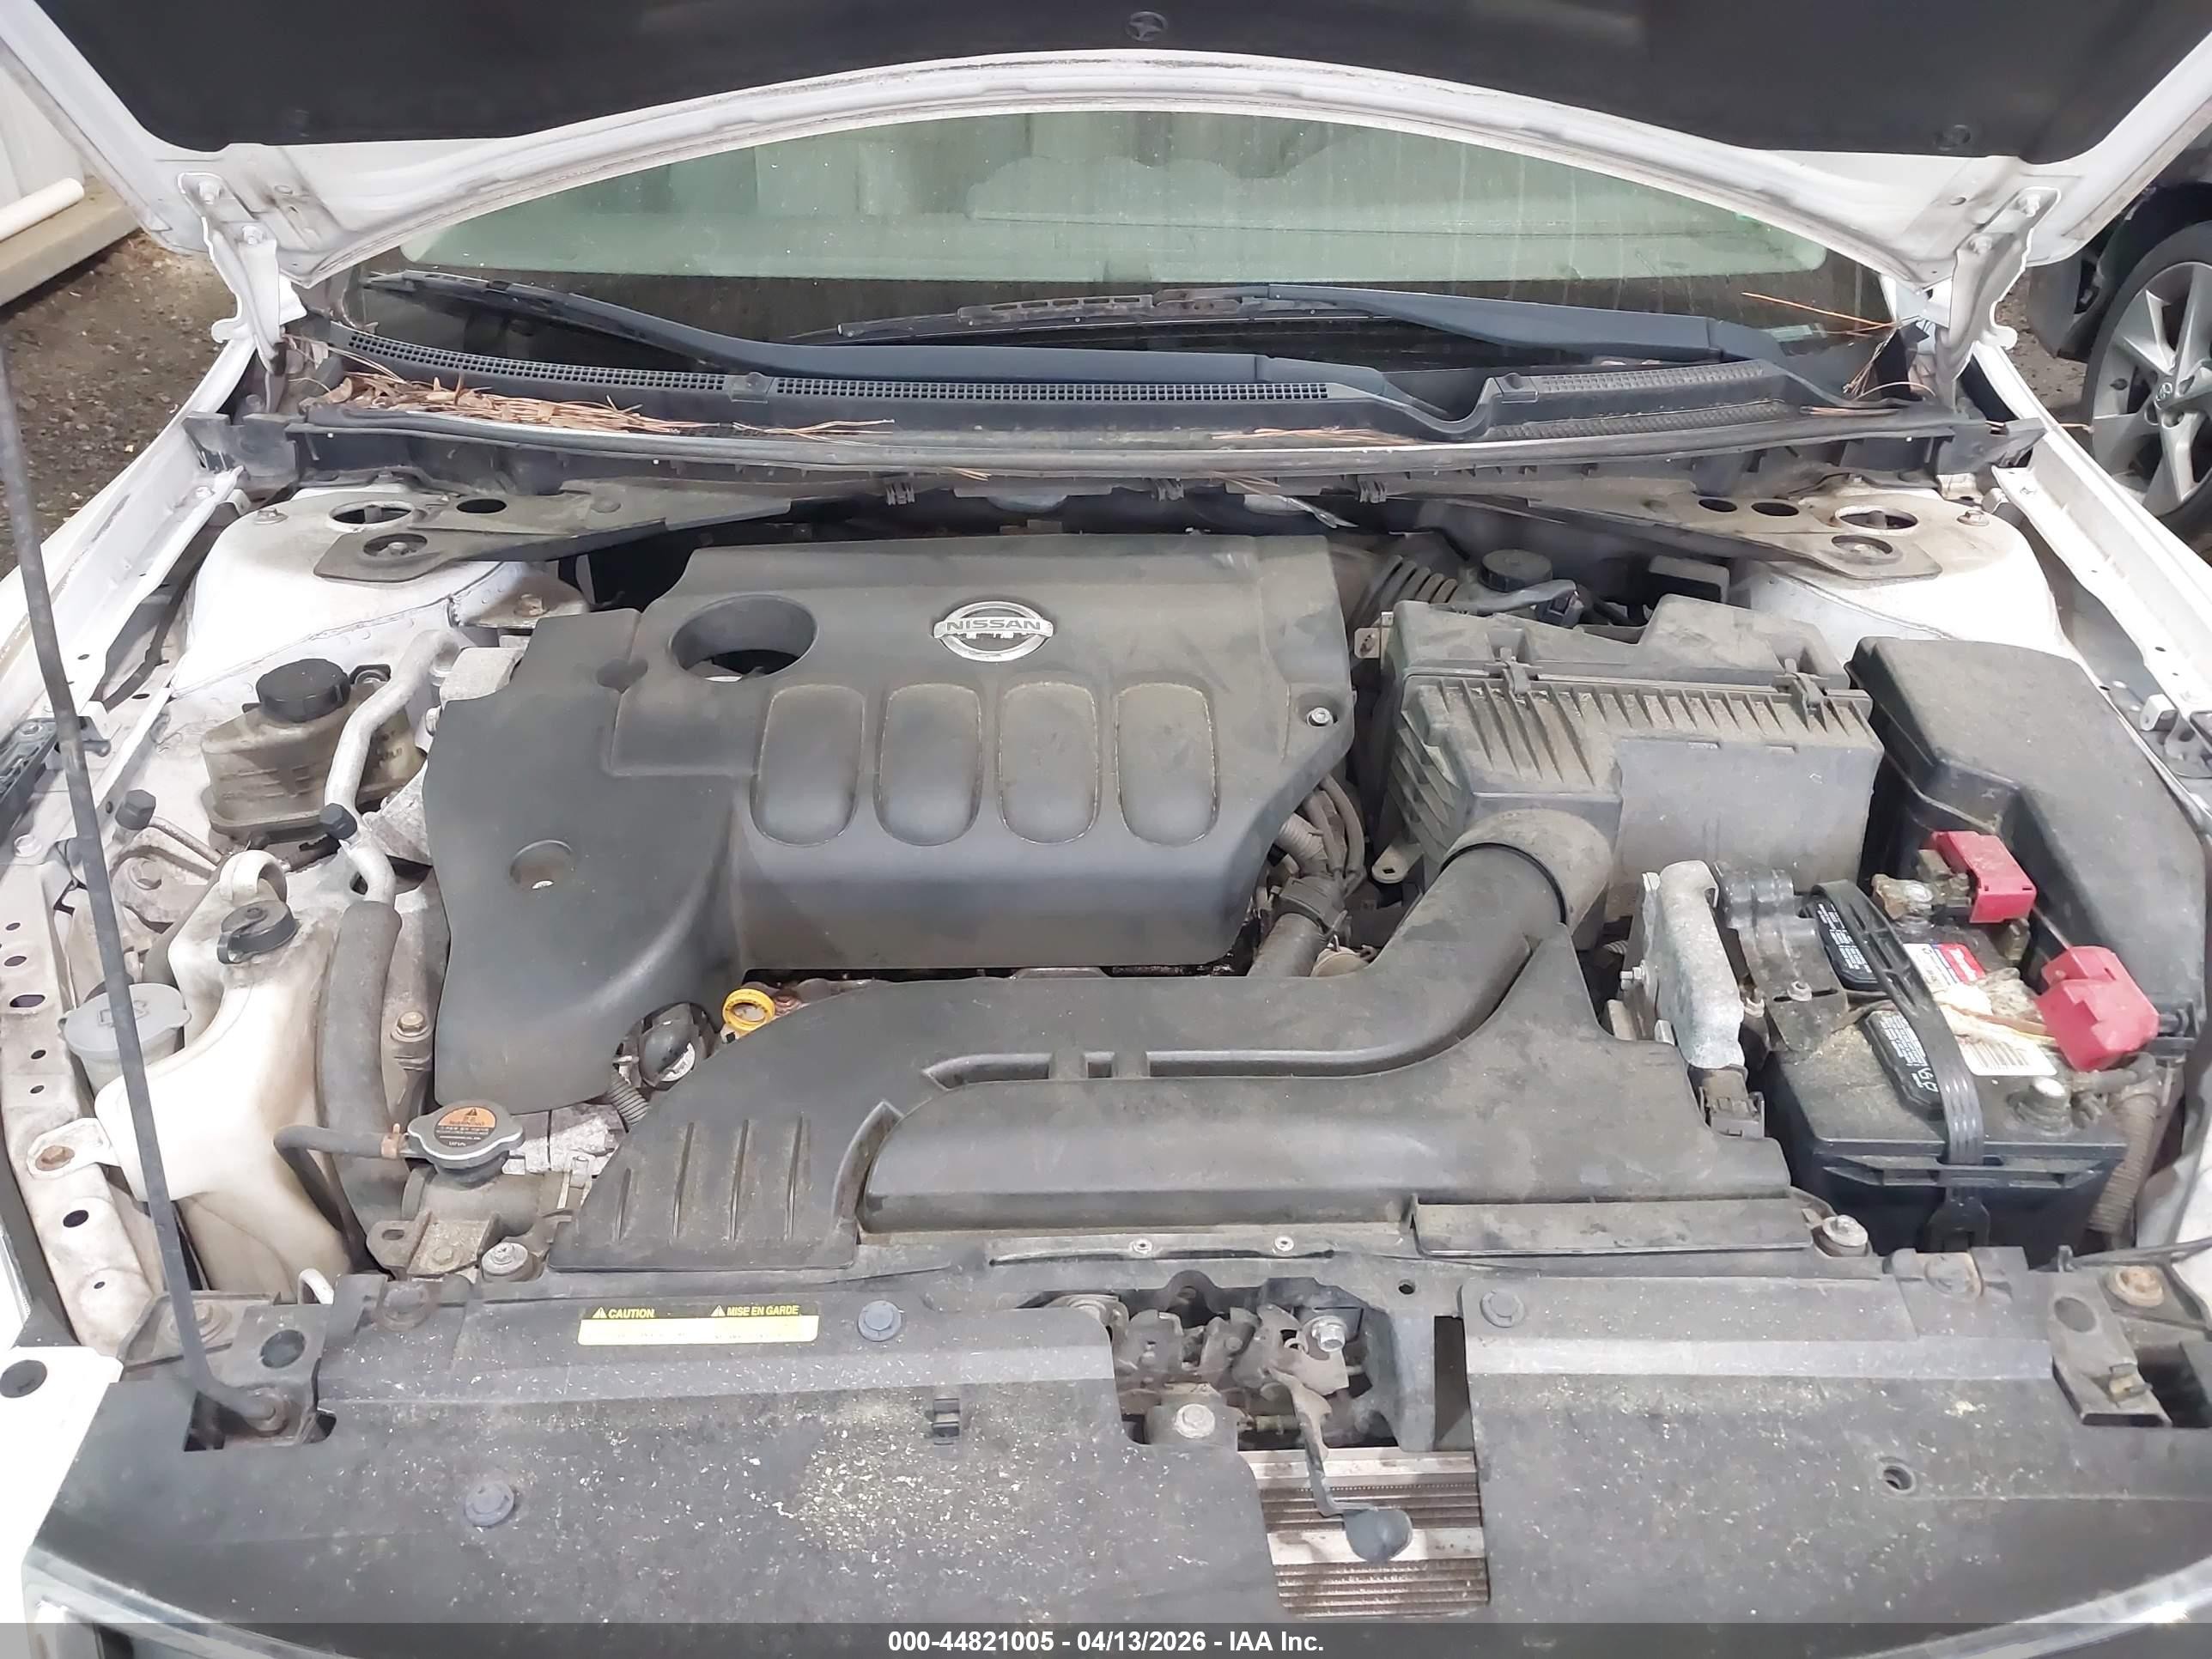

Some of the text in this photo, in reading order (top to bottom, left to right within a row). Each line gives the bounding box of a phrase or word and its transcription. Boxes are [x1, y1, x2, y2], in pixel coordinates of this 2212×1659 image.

[947, 619, 1041, 630] NISSAN
[608, 1308, 655, 1319] CAUTION
[726, 1304, 800, 1316] MISE EN GARDE
